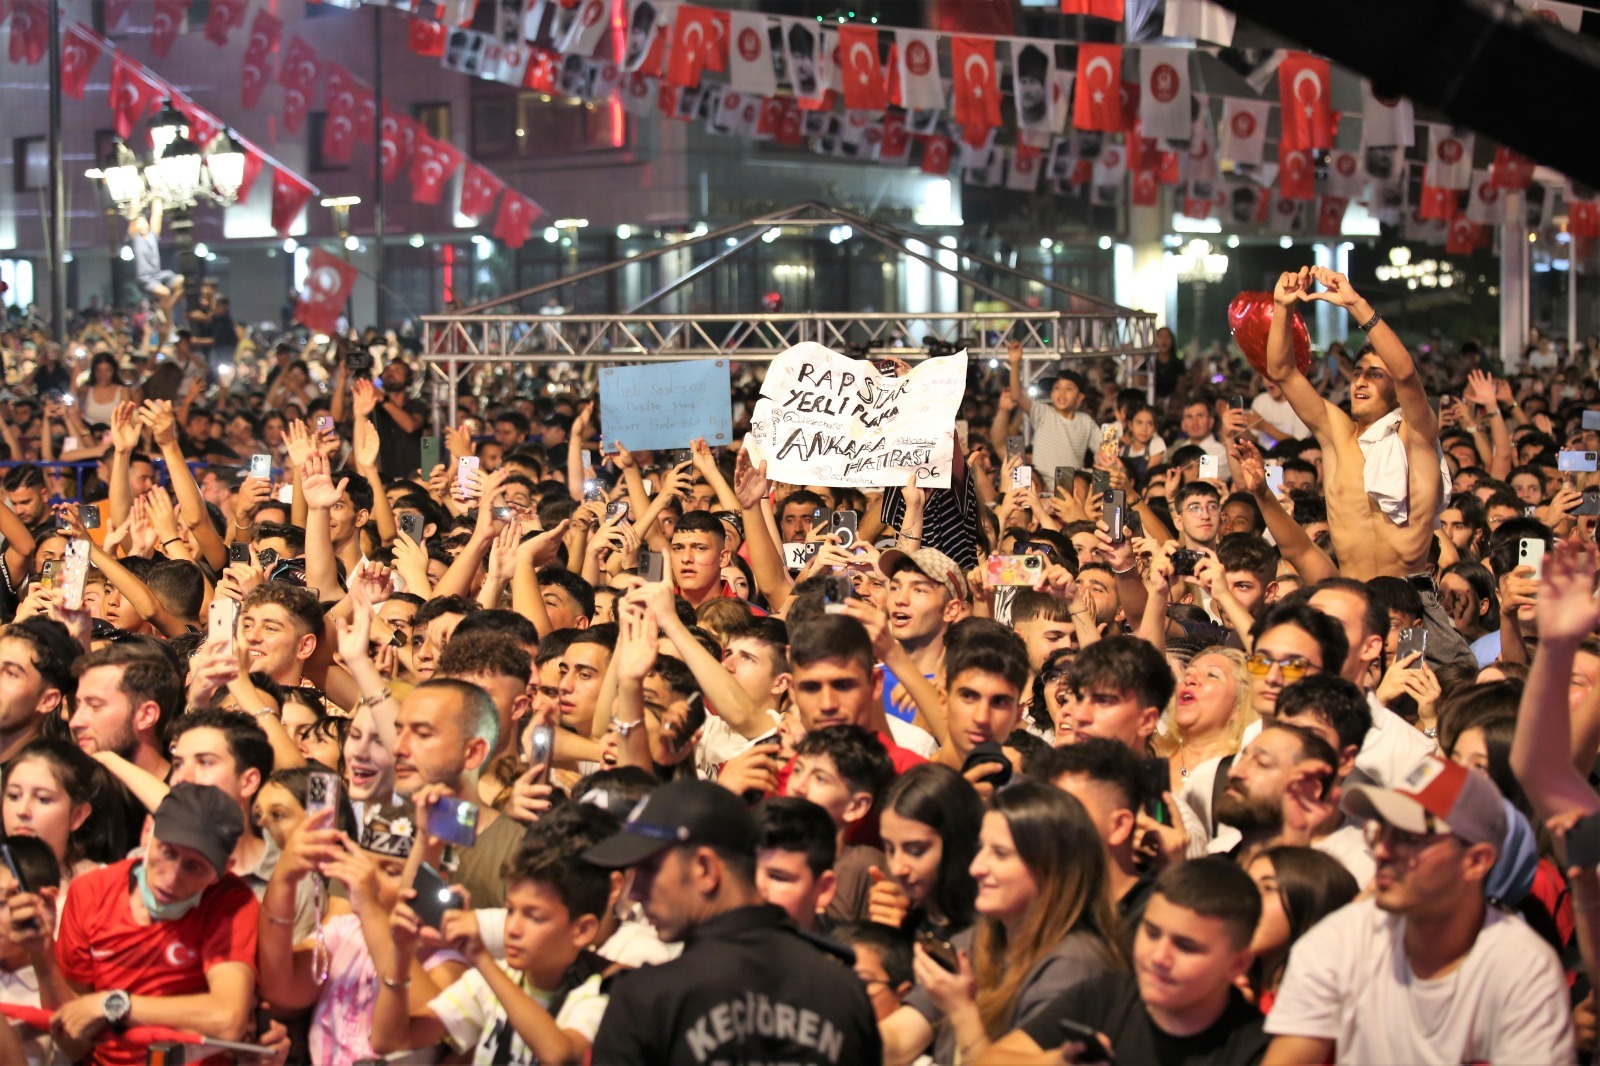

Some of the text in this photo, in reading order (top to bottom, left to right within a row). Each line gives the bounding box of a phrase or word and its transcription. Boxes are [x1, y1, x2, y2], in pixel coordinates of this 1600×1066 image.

[797, 363, 911, 410] RAP STAR
[776, 428, 886, 461] ANKARA
[915, 466, 940, 479] 06
